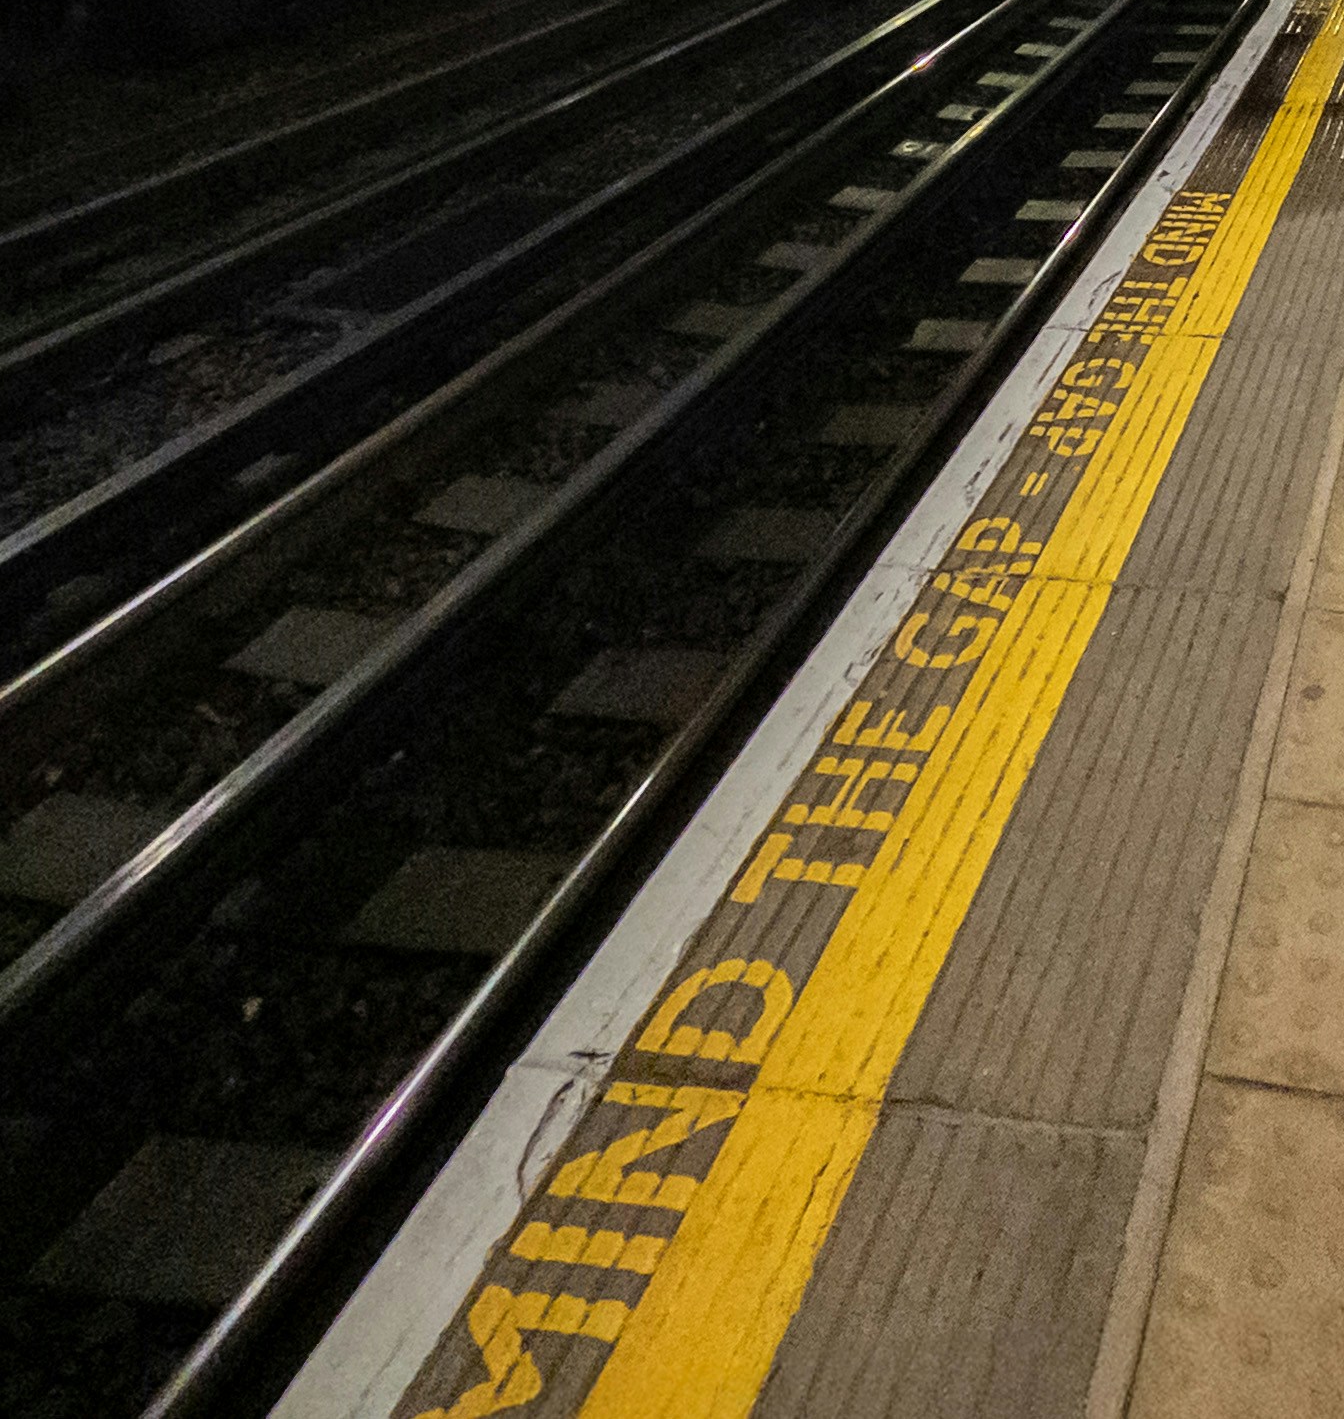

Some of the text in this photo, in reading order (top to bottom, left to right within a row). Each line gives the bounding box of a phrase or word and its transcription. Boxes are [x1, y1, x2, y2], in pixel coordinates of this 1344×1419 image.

[1030, 191, 1233, 457] MIND THE GAP
[409, 516, 1043, 1419] MIND THE GAP
